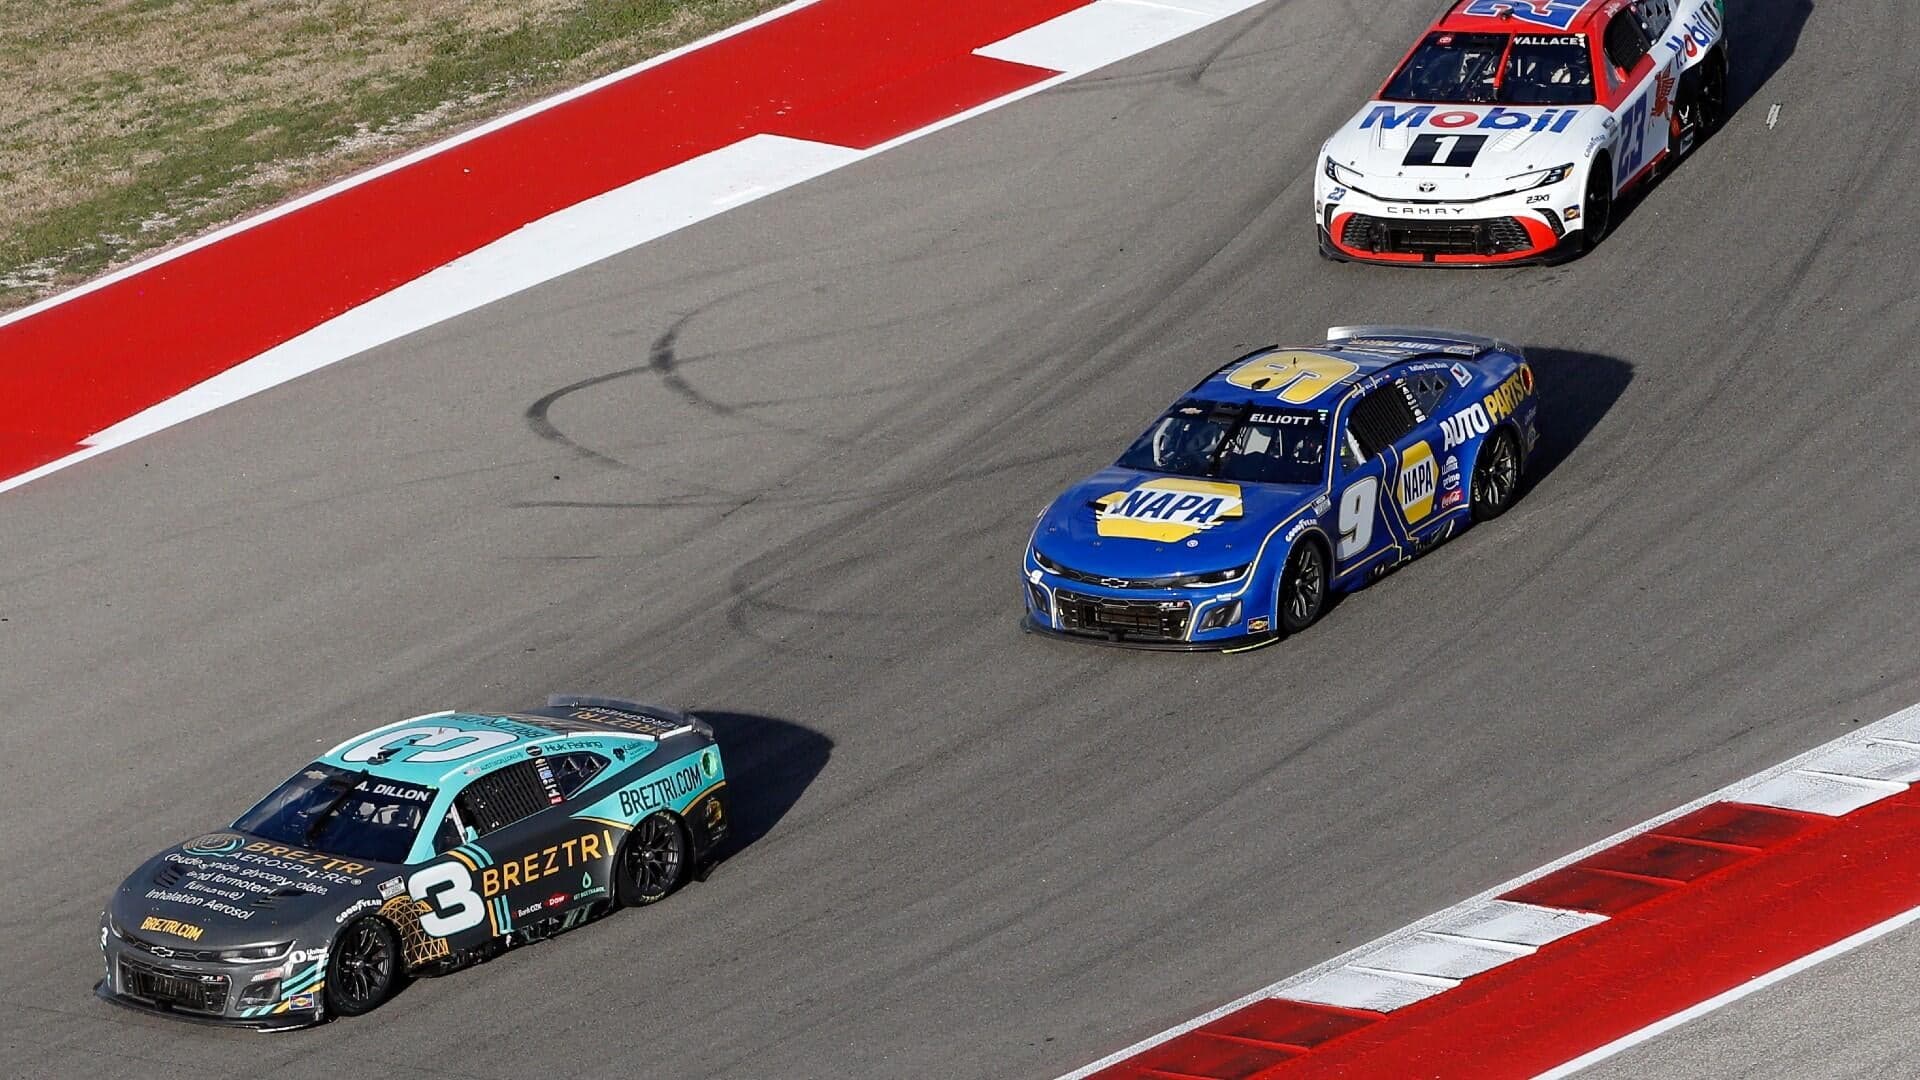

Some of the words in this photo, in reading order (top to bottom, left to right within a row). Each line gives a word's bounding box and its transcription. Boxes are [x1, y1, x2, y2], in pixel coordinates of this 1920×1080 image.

[1512, 36, 1579, 45] WALLACE
[1665, 11, 1716, 69] Mobil
[1359, 105, 1580, 134] Mobil
[1431, 136, 1460, 164] 1
[1387, 206, 1465, 215] CAMRY
[1250, 413, 1313, 426] ELLIOTT
[1440, 402, 1490, 452] AUTO
[1483, 371, 1525, 426] PARTS
[1403, 460, 1433, 505] NAPA
[1110, 490, 1225, 524] NAPA
[1337, 474, 1379, 560] 9
[340, 726, 521, 763] 3
[355, 780, 369, 792] A.
[373, 783, 430, 802] DILLON
[619, 763, 703, 818] BREZTRI.COM
[243, 842, 375, 876] BREZTRI
[482, 829, 615, 897] BREZTRI
[145, 888, 204, 906] Inhalation
[203, 899, 255, 920] Aerosol
[335, 899, 383, 923] GOODYEAR
[408, 860, 486, 938] 3
[140, 916, 204, 941] BREZTRI.COM
